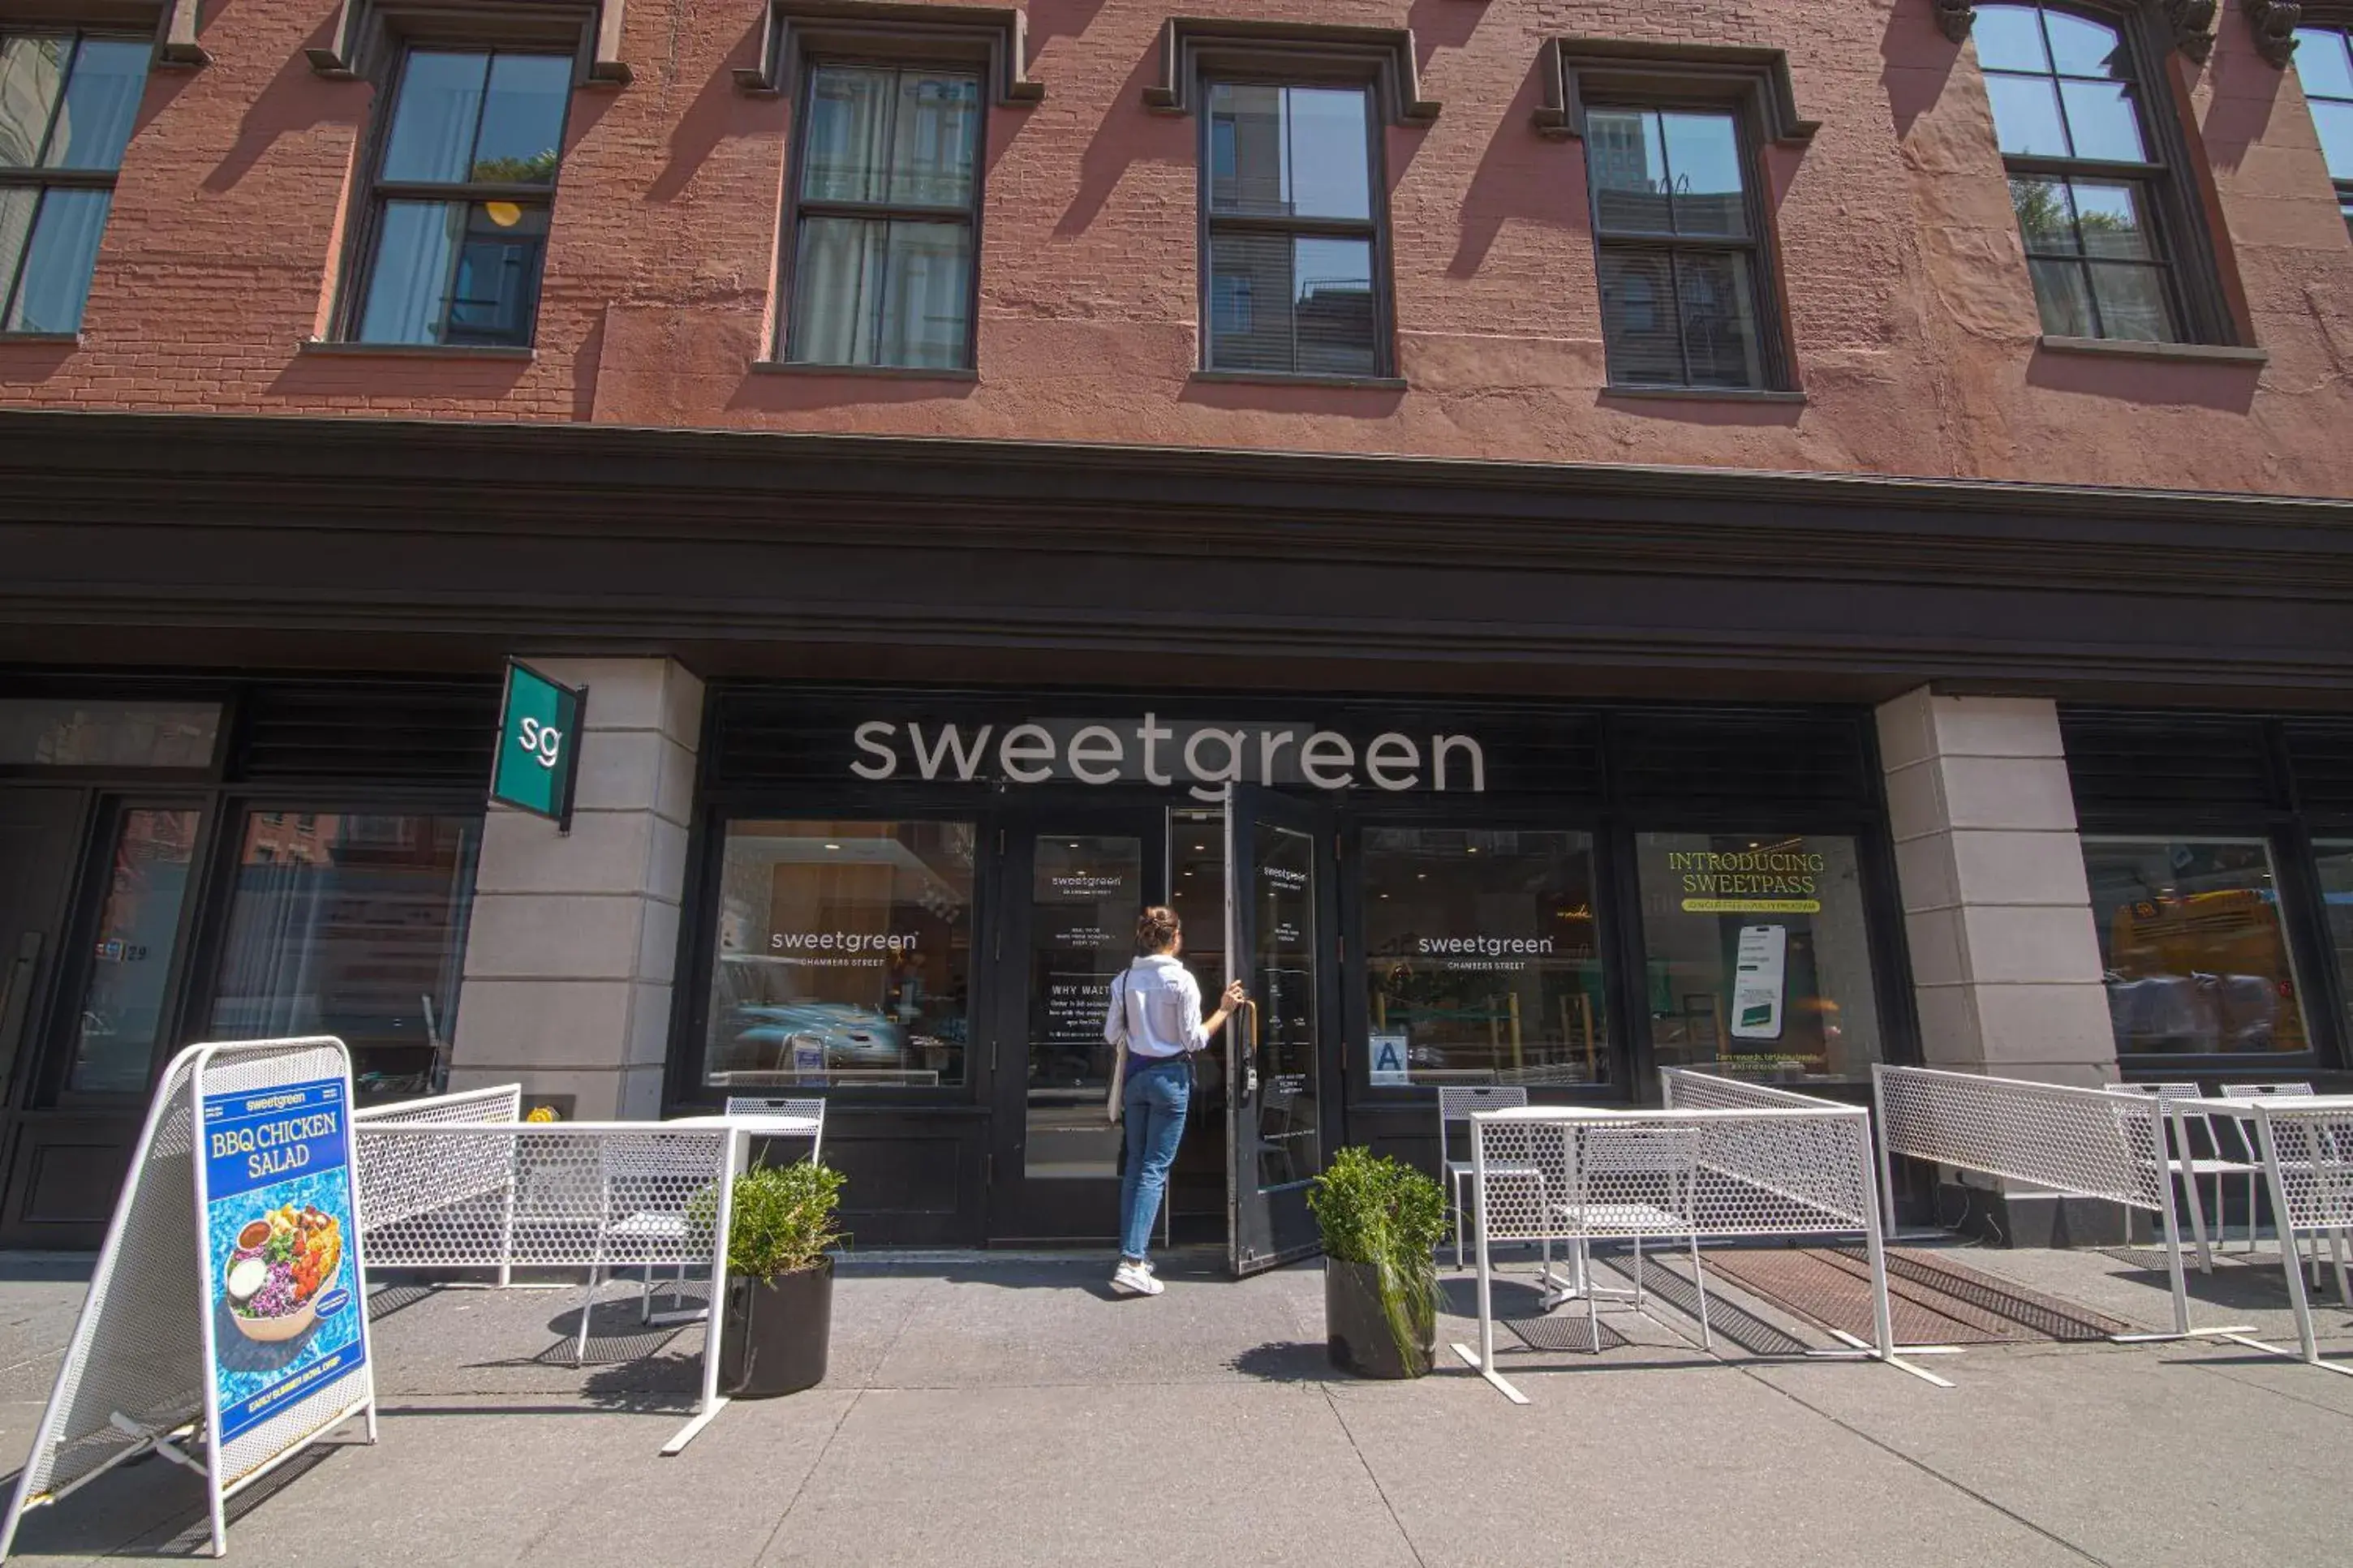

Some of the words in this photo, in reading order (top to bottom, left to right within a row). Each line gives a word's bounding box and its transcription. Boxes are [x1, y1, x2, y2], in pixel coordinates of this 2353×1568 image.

[518, 717, 562, 767] sg
[849, 711, 1486, 801] sweetgreen
[1669, 852, 1824, 871] INTRODUCING
[1052, 877, 1121, 887] sweetgreen
[1683, 874, 1815, 893] SWEETPASS
[772, 931, 917, 952] sweetgreen
[1418, 934, 1552, 956] sweetgreen
[800, 958, 849, 967] CHAMBERS
[851, 958, 885, 967] STREET
[1448, 961, 1493, 970] CHAMBERS
[1495, 961, 1525, 970] STREET
[1052, 985, 1077, 995] WHY
[1376, 1042, 1401, 1072] A
[246, 1092, 306, 1111] sweetgreen
[212, 1128, 256, 1158] BBQ
[256, 1111, 338, 1148] CHICKEN
[248, 1144, 310, 1179] SALAD
